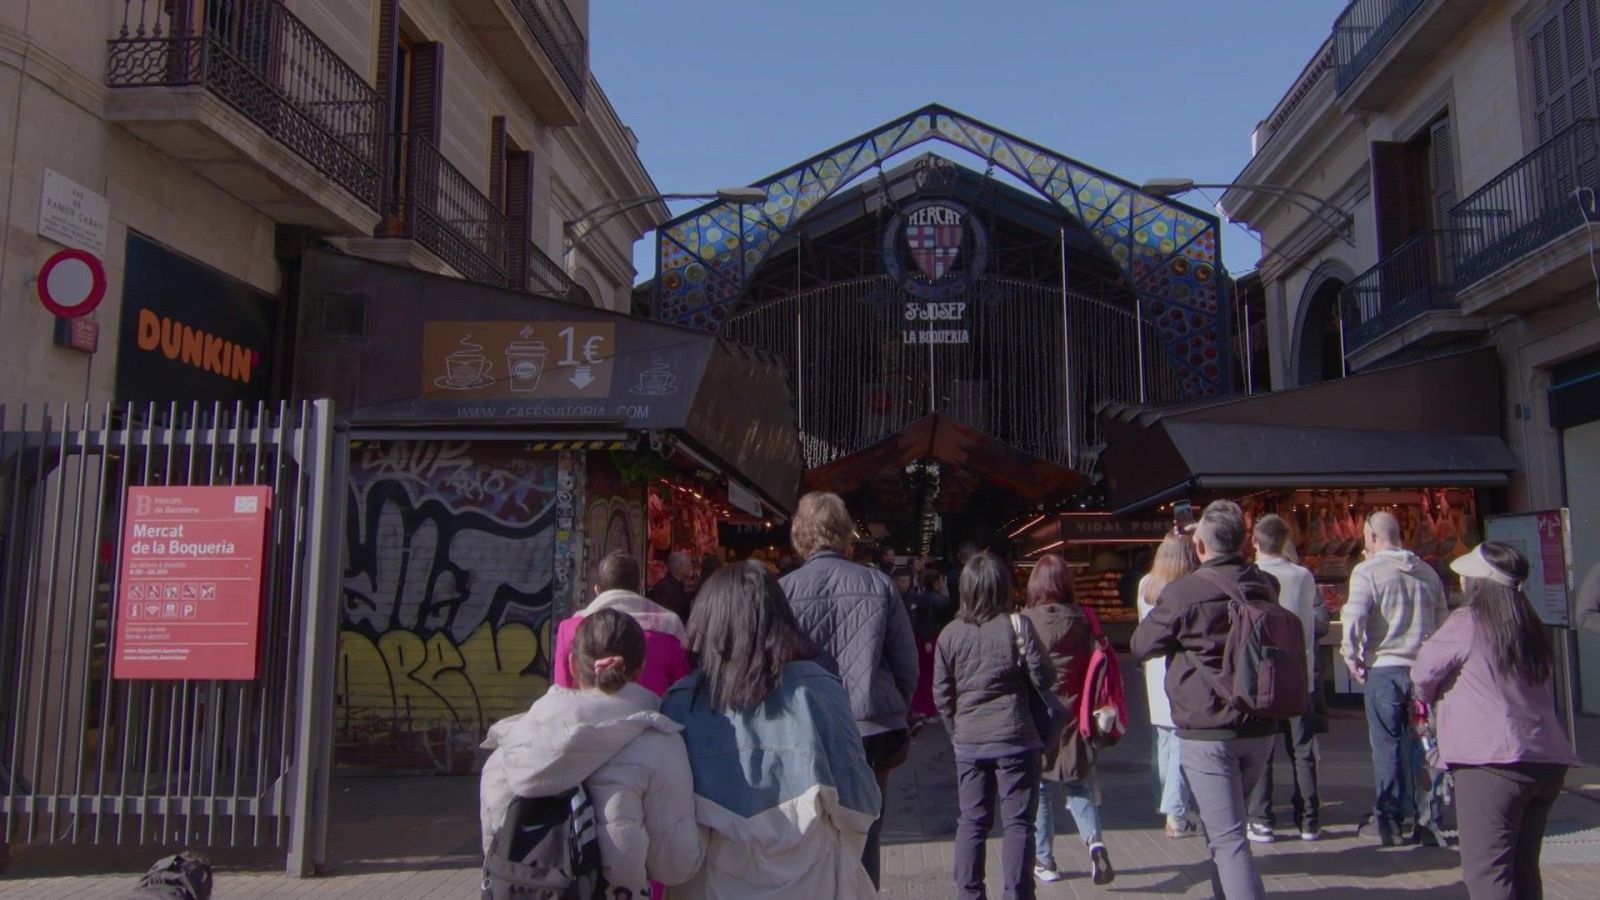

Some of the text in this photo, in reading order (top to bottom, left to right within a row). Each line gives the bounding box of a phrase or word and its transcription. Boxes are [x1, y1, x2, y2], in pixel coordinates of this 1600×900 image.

[909, 206, 962, 225] MERCAT
[920, 302, 966, 320] JOSEP
[903, 329, 970, 344] LA BOQUERIA
[557, 326, 604, 366] 1€
[133, 523, 184, 538] Mercat
[1076, 520, 1123, 532] VIDAL
[131, 539, 235, 557] de la Boqueria
